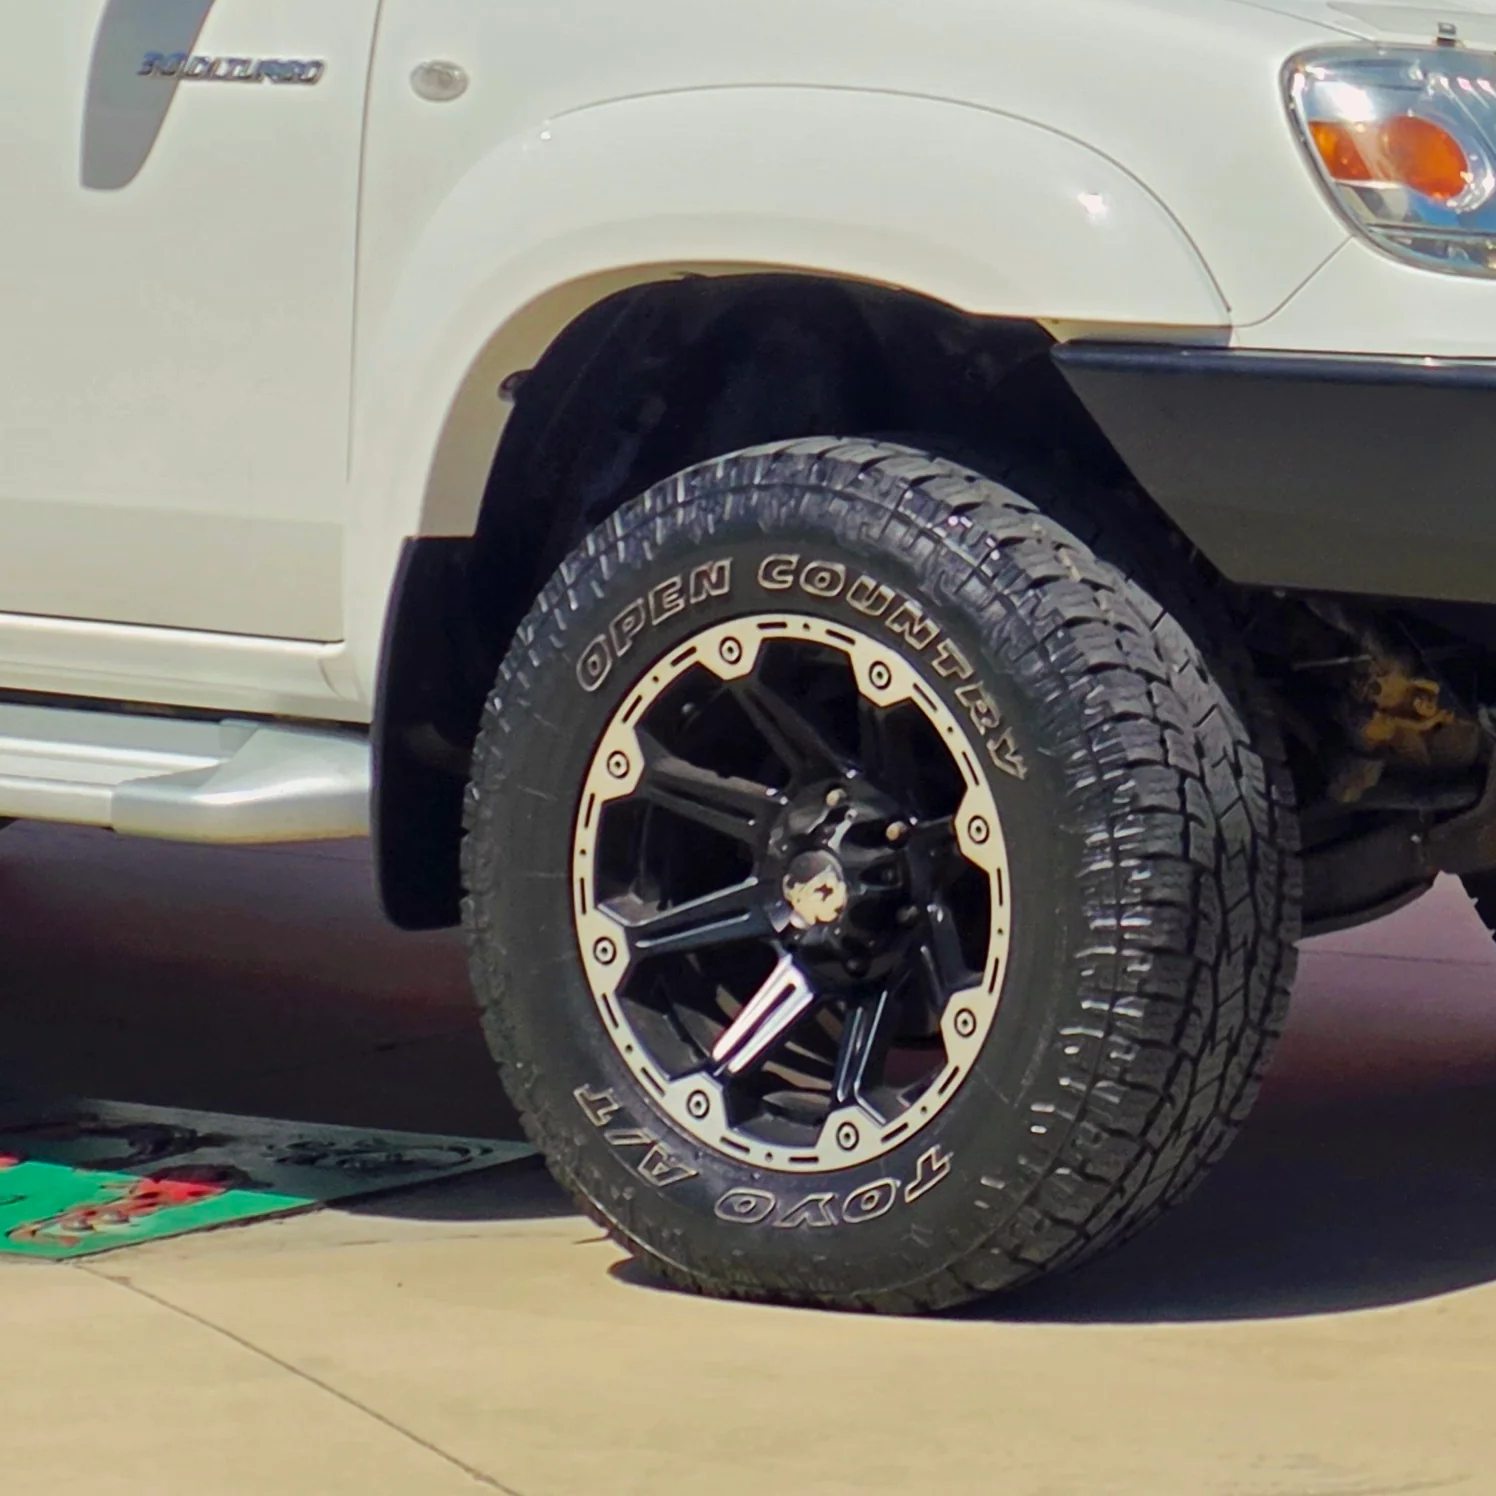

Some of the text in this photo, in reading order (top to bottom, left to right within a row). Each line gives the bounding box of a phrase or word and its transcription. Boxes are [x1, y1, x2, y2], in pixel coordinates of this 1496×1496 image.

[576, 554, 1028, 780] OPEN COUNTRY
[573, 1083, 699, 1187] A/T
[714, 1145, 954, 1228] TOYO
